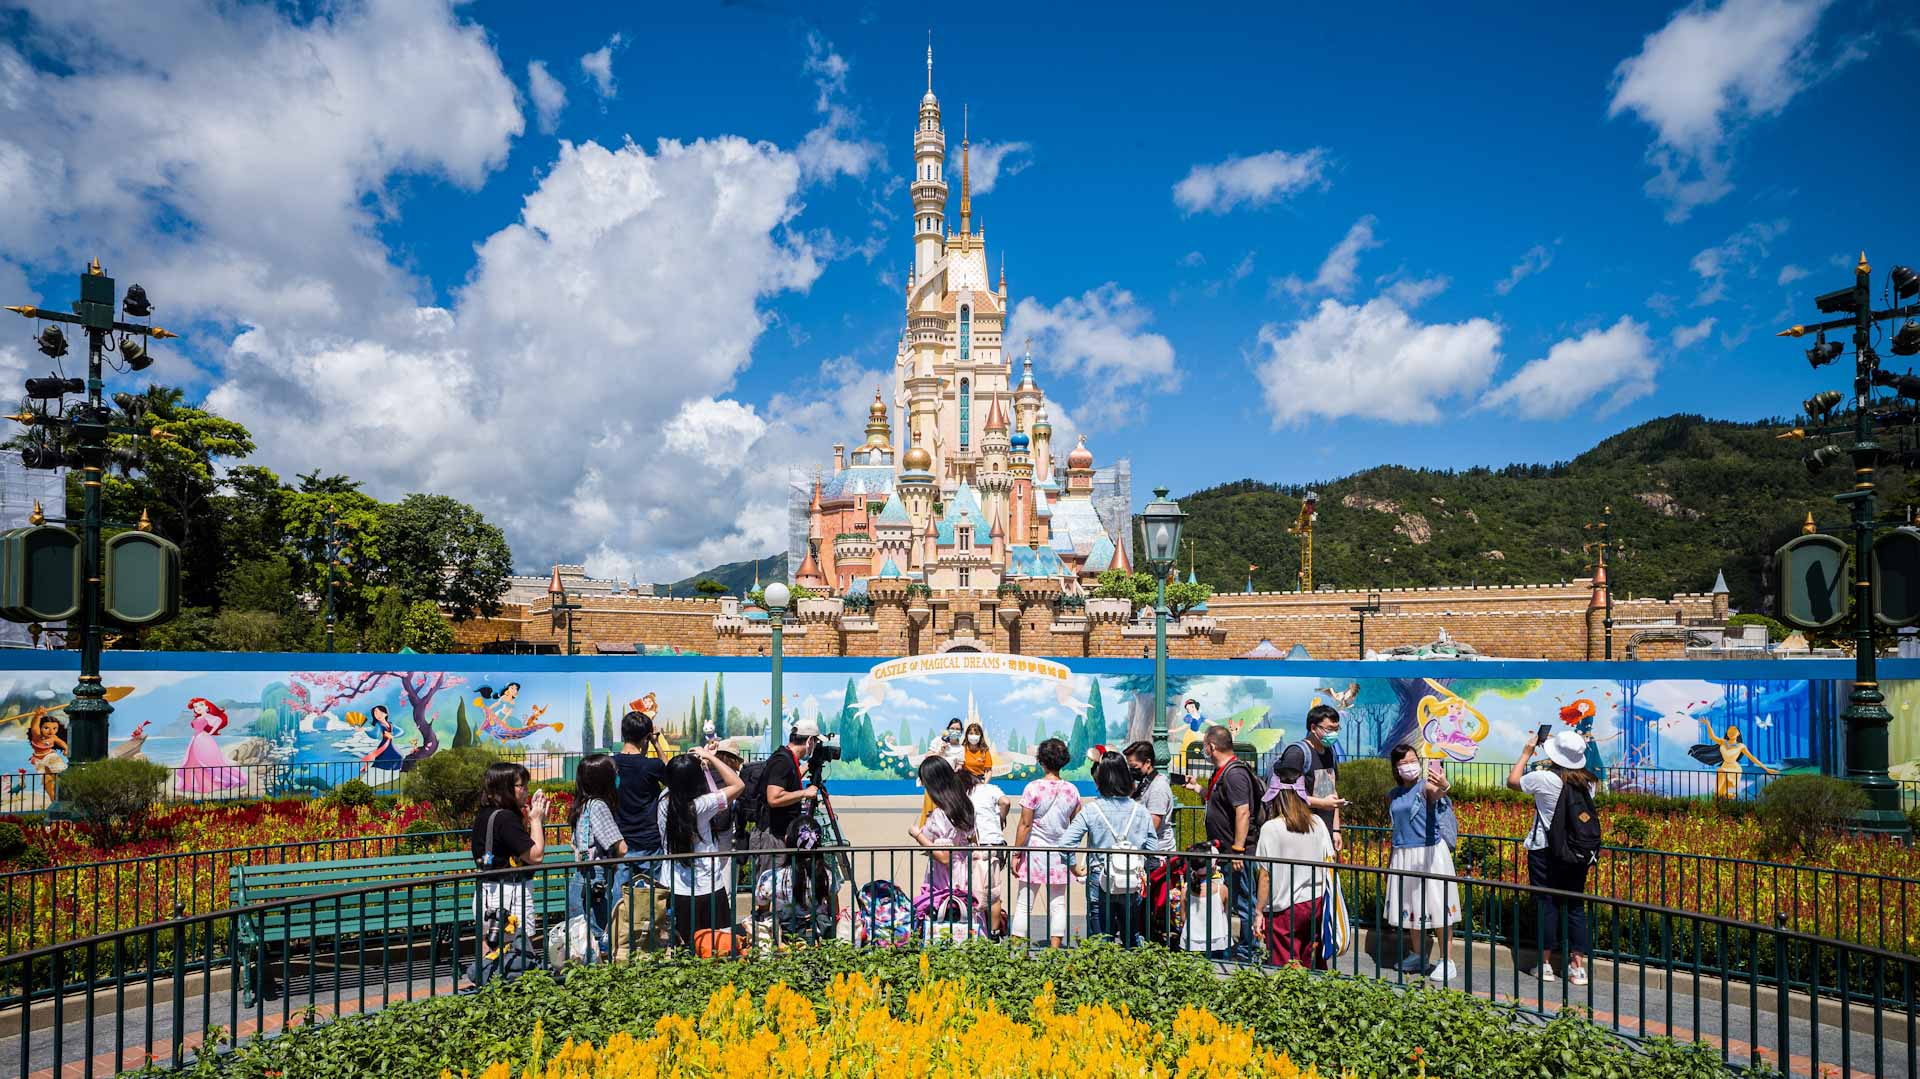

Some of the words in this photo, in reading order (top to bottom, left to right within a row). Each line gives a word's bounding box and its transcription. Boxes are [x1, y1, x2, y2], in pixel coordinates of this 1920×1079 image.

[874, 662, 907, 679] CASTLE
[920, 657, 960, 671] MAGICAL
[964, 655, 1000, 669] DREAMS
